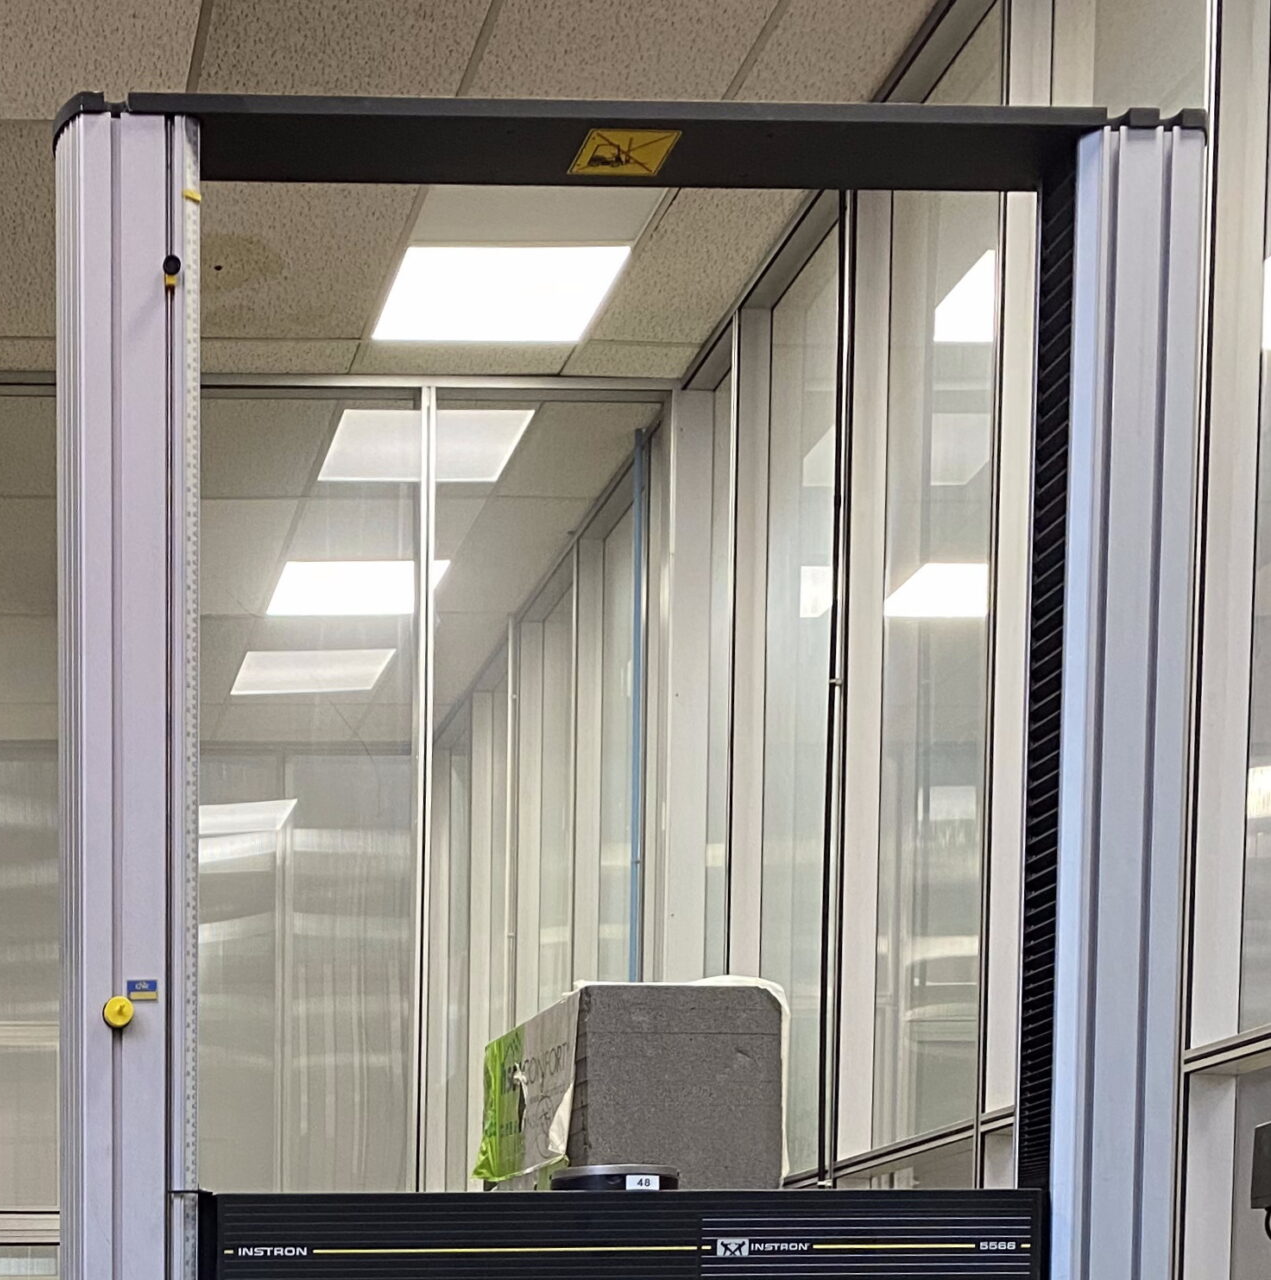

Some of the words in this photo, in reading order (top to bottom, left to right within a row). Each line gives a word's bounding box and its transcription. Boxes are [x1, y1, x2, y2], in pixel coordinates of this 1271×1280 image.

[636, 1177, 651, 1188] 48
[238, 1246, 307, 1256] INSTRON
[750, 1242, 809, 1251] INSTRON
